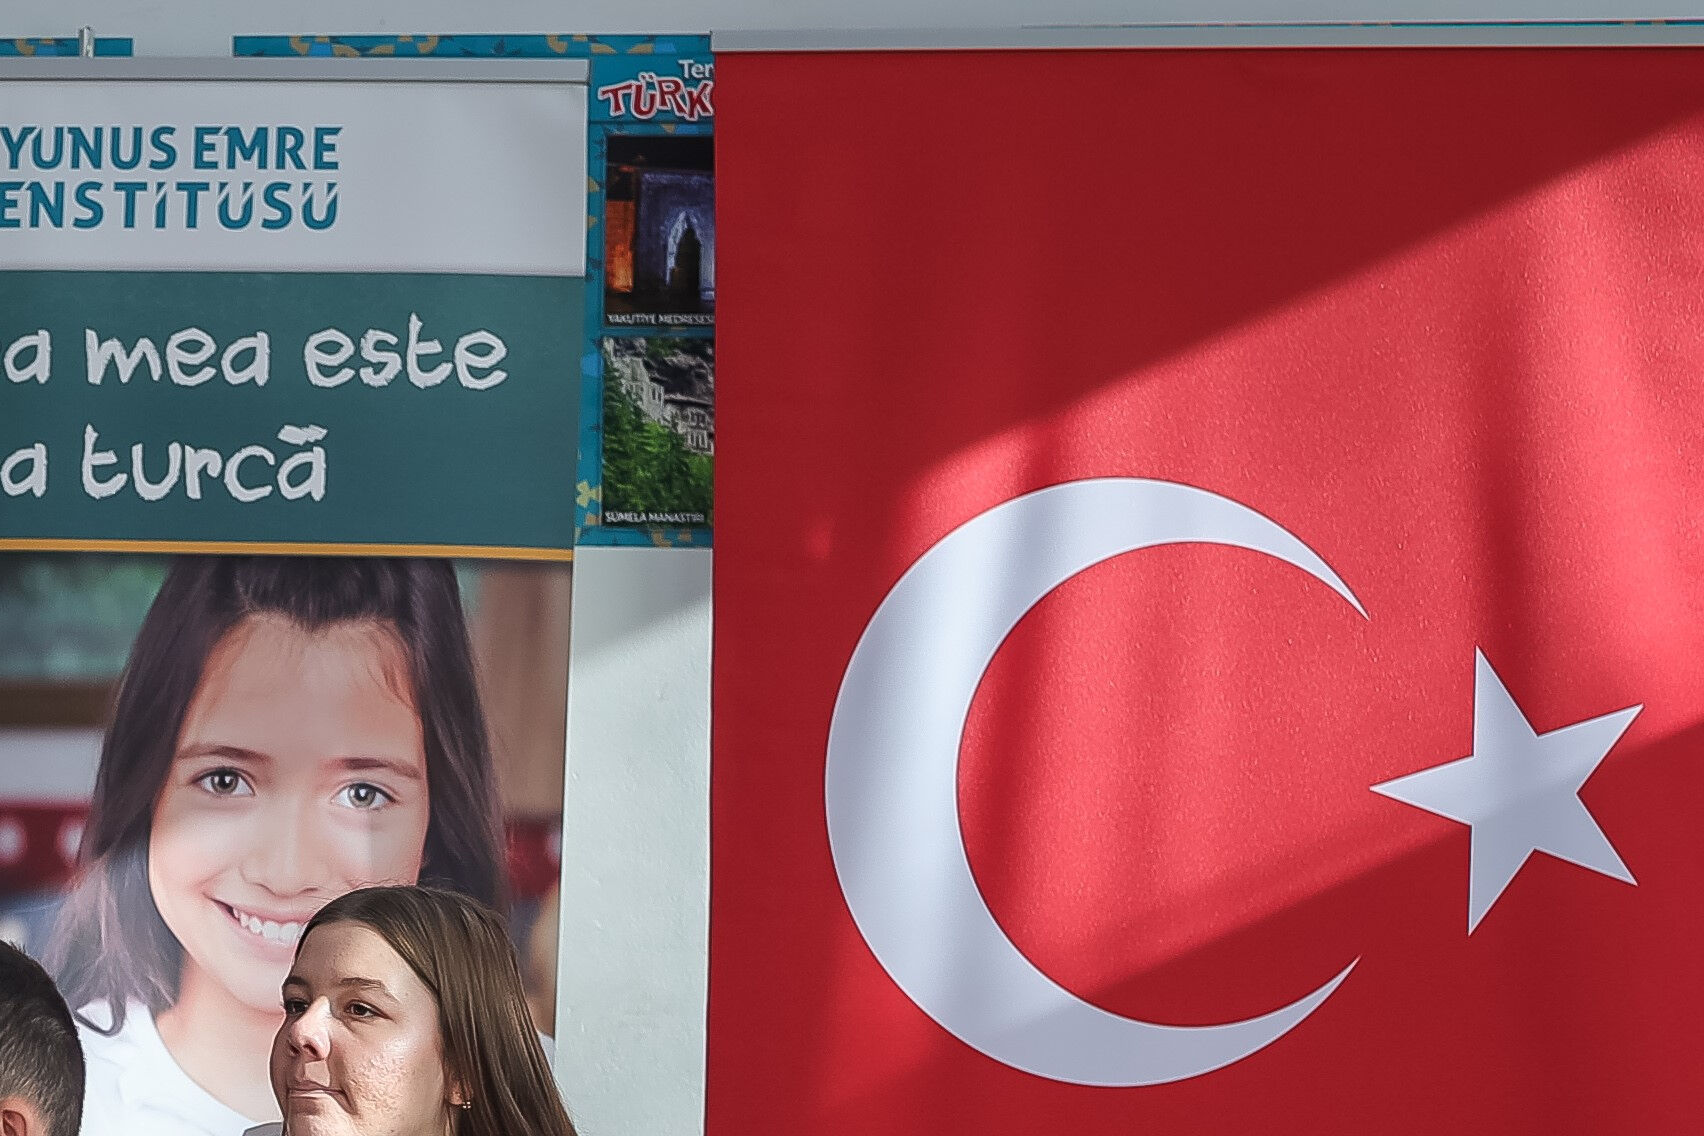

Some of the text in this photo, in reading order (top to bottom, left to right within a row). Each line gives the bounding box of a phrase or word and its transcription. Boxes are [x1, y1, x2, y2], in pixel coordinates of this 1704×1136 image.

[194, 126, 343, 170] EMRE
[85, 326, 270, 387] mea
[303, 311, 508, 390] este
[81, 423, 328, 502] turcă
